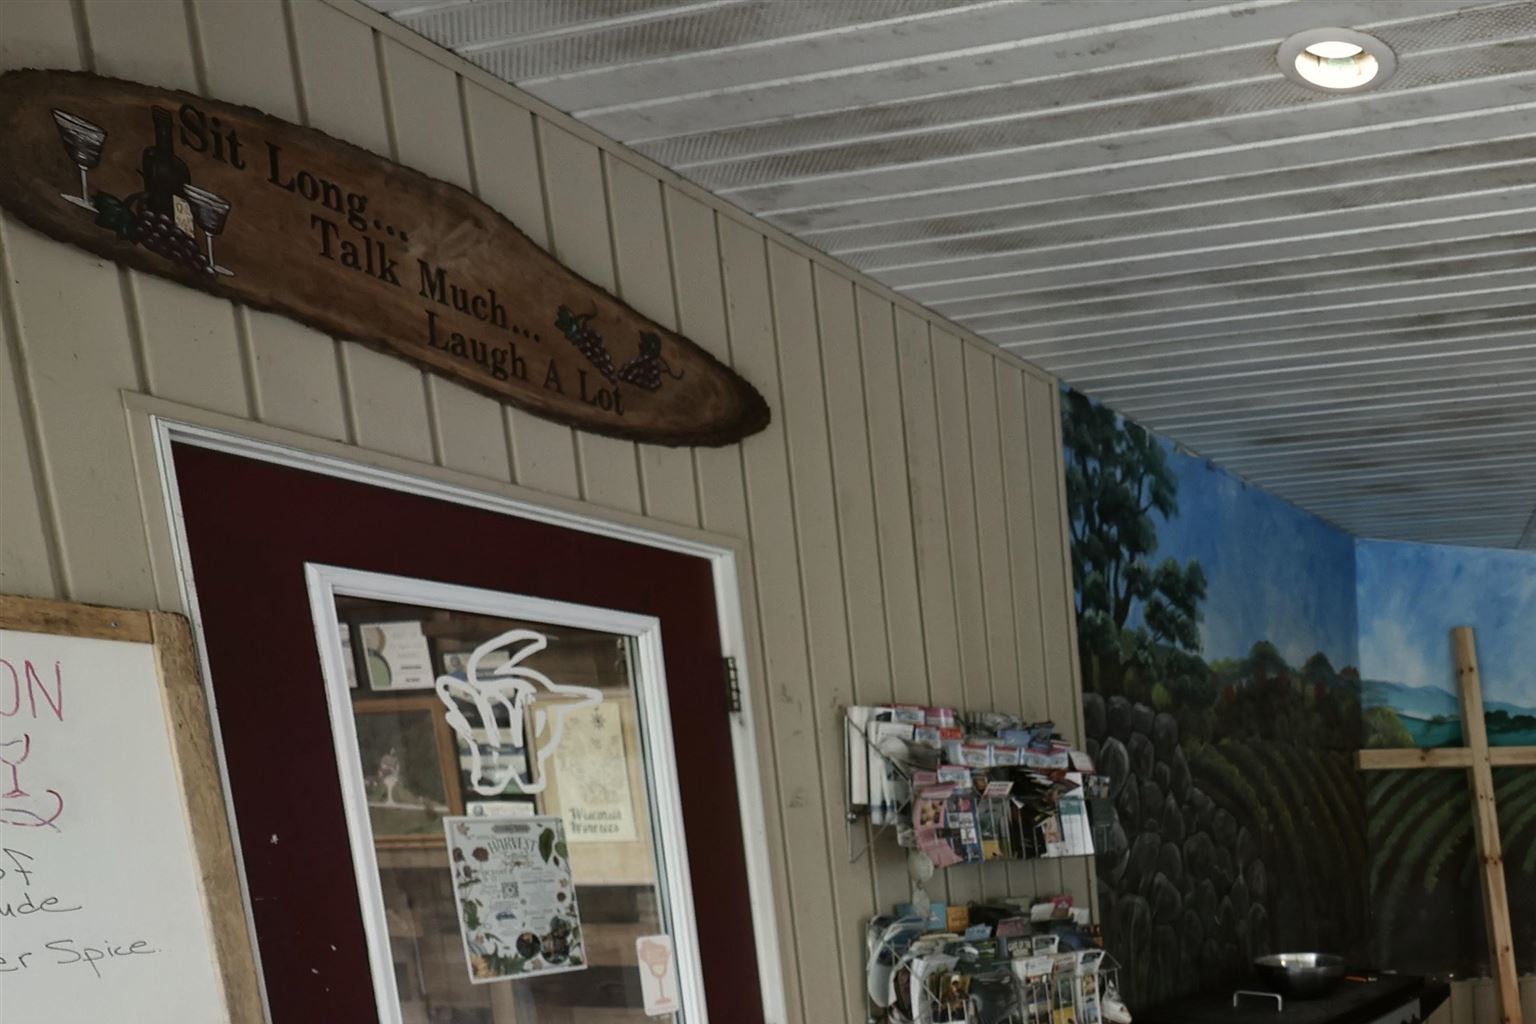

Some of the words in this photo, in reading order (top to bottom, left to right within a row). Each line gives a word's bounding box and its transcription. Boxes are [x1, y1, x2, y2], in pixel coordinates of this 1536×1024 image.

[178, 103, 245, 170] Sit
[266, 142, 410, 243] Long...
[309, 214, 400, 286] Talk
[417, 258, 541, 343] Much...
[424, 309, 528, 383] Laugh
[542, 360, 566, 396] A
[578, 369, 625, 417] Lot
[487, 837, 537, 855] HARVEST
